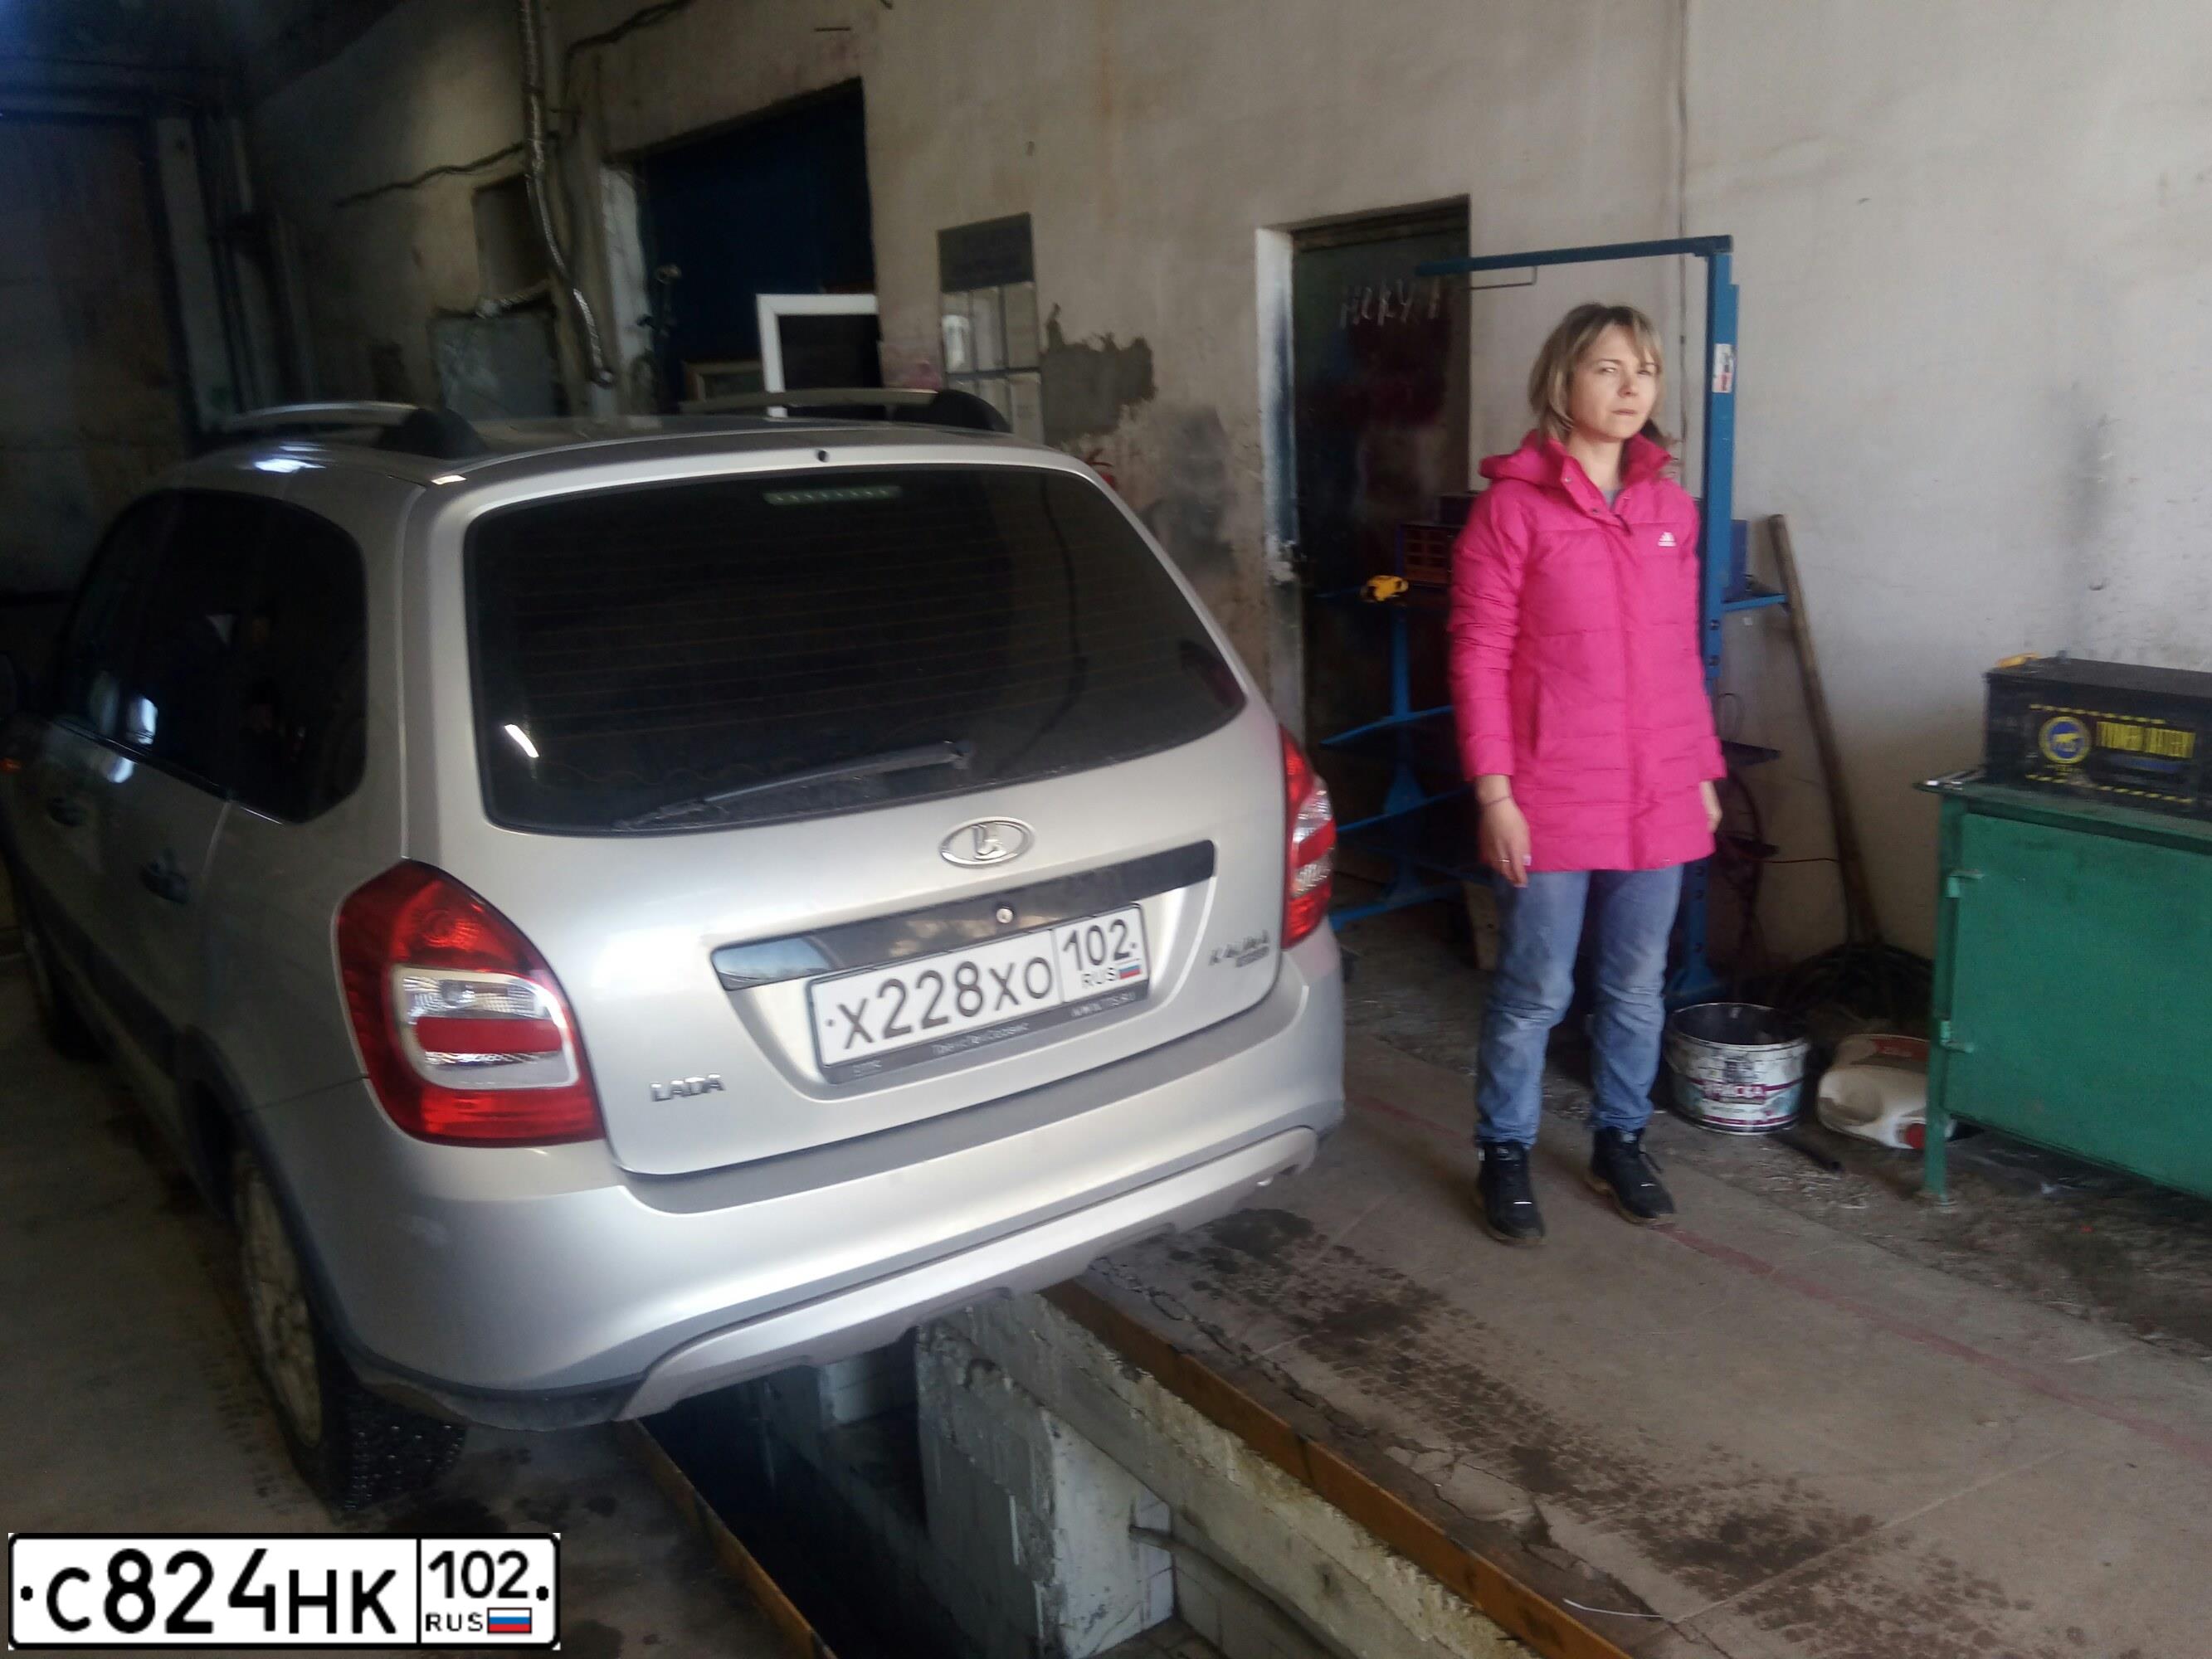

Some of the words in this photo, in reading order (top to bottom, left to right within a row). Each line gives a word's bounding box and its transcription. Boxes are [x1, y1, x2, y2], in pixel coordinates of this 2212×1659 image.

[1063, 918, 1132, 971] 102
[1081, 966, 1118, 989] RUS
[650, 1073, 726, 1102] LADA
